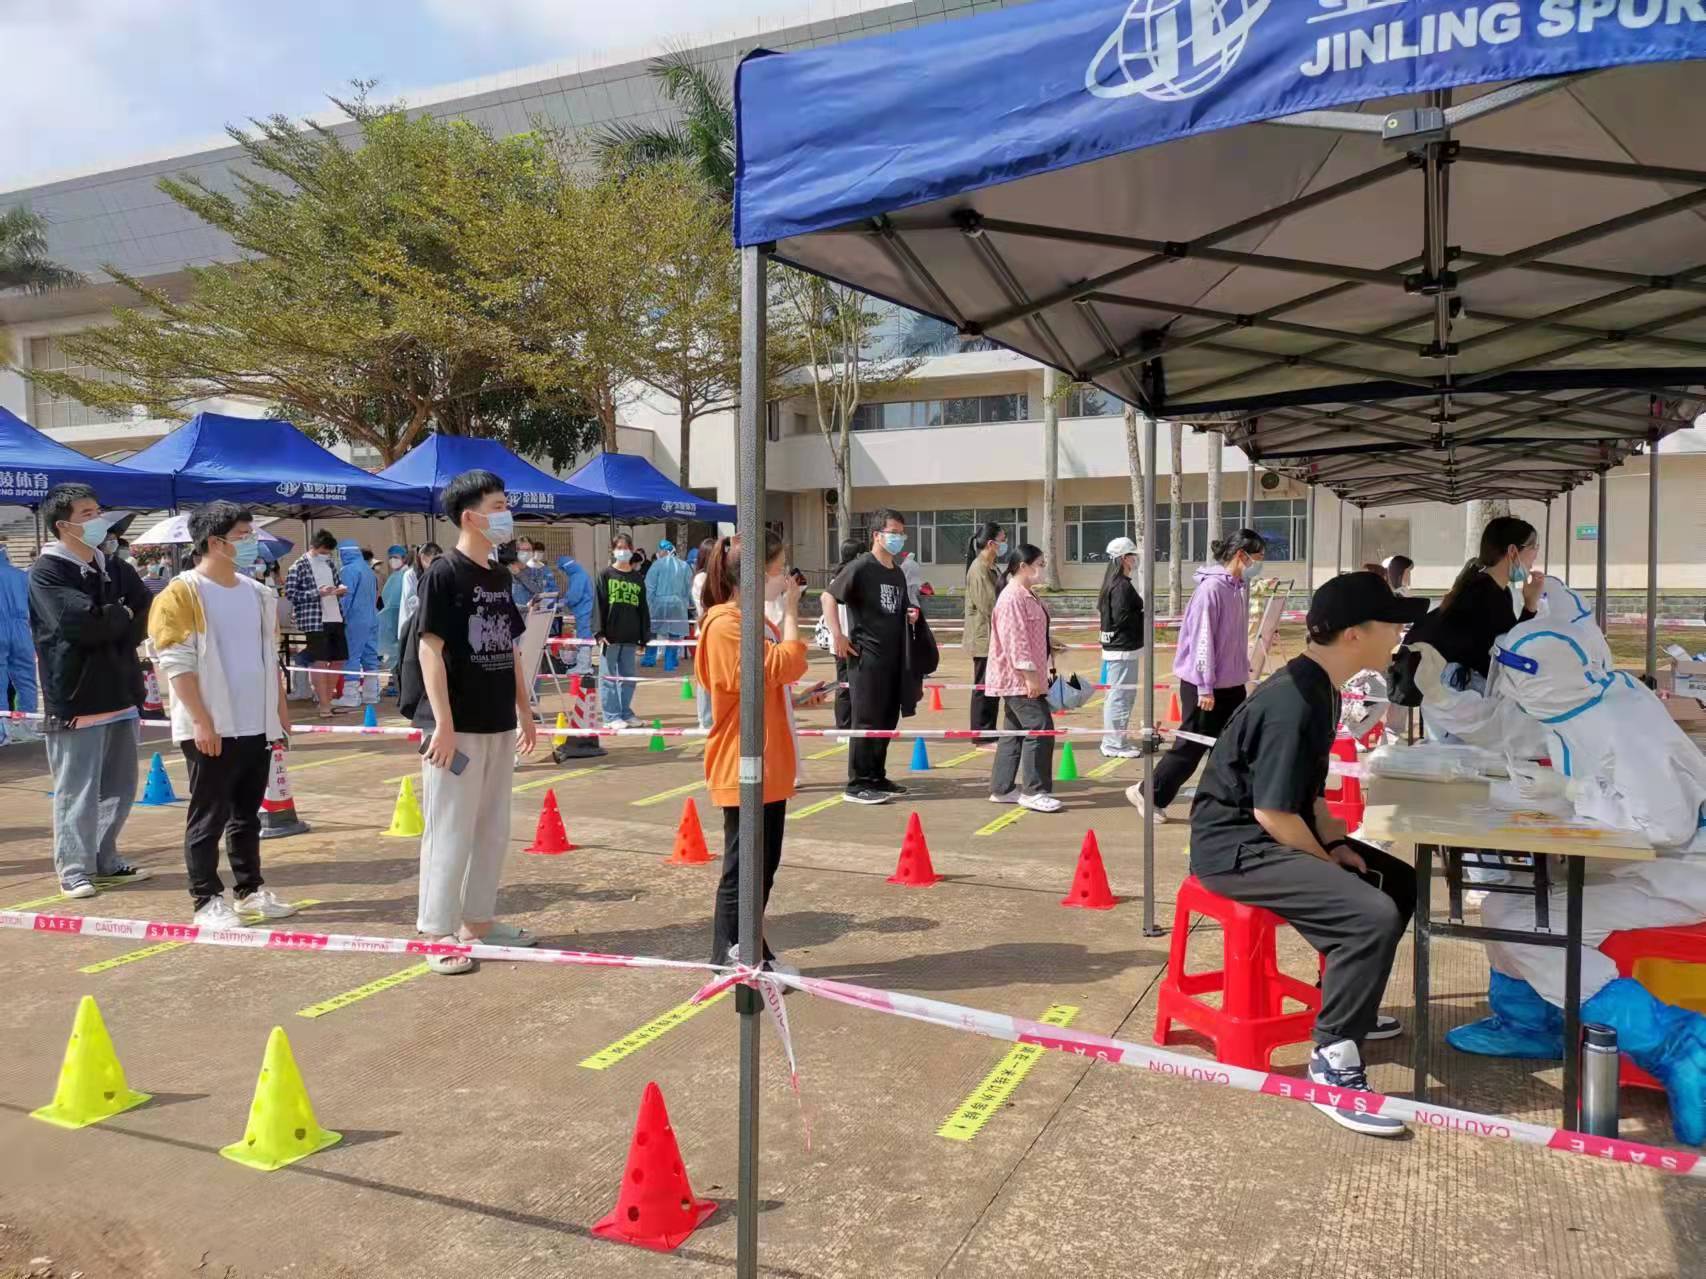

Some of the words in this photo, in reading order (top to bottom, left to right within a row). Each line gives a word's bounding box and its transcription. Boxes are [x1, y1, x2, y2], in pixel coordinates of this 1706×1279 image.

[1300, 2, 1521, 77] JINLING
[38, 917, 77, 930] SAFE
[95, 922, 133, 935] CAUTION
[150, 926, 193, 938] SAFE
[212, 930, 254, 943] CAUTION
[1148, 1059, 1231, 1086] CAUTION
[1279, 1082, 1367, 1113] SAFE
[1414, 1109, 1511, 1139] CAUTION
[1569, 1138, 1678, 1170] SAFE
